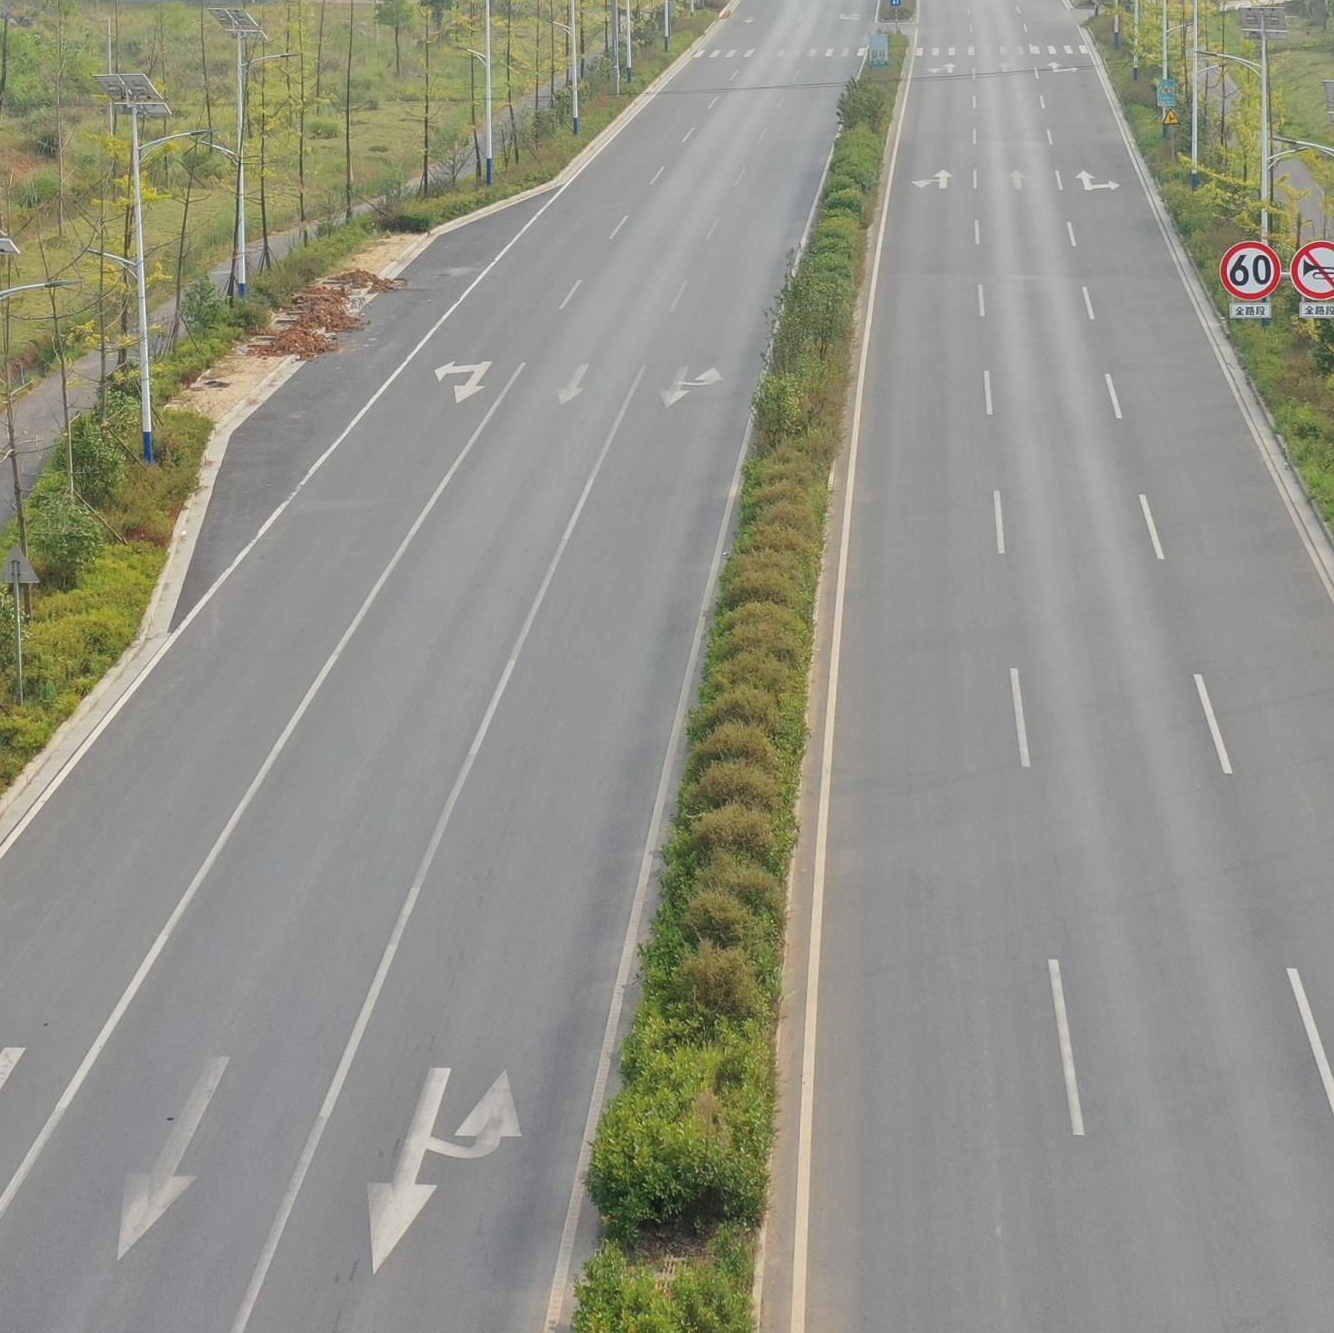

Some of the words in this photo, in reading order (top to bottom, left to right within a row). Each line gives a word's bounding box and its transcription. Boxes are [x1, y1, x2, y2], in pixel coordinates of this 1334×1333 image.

[1230, 255, 1271, 286] 60
[1235, 306, 1265, 316] 全路段
[1305, 305, 1334, 316] 全路段
